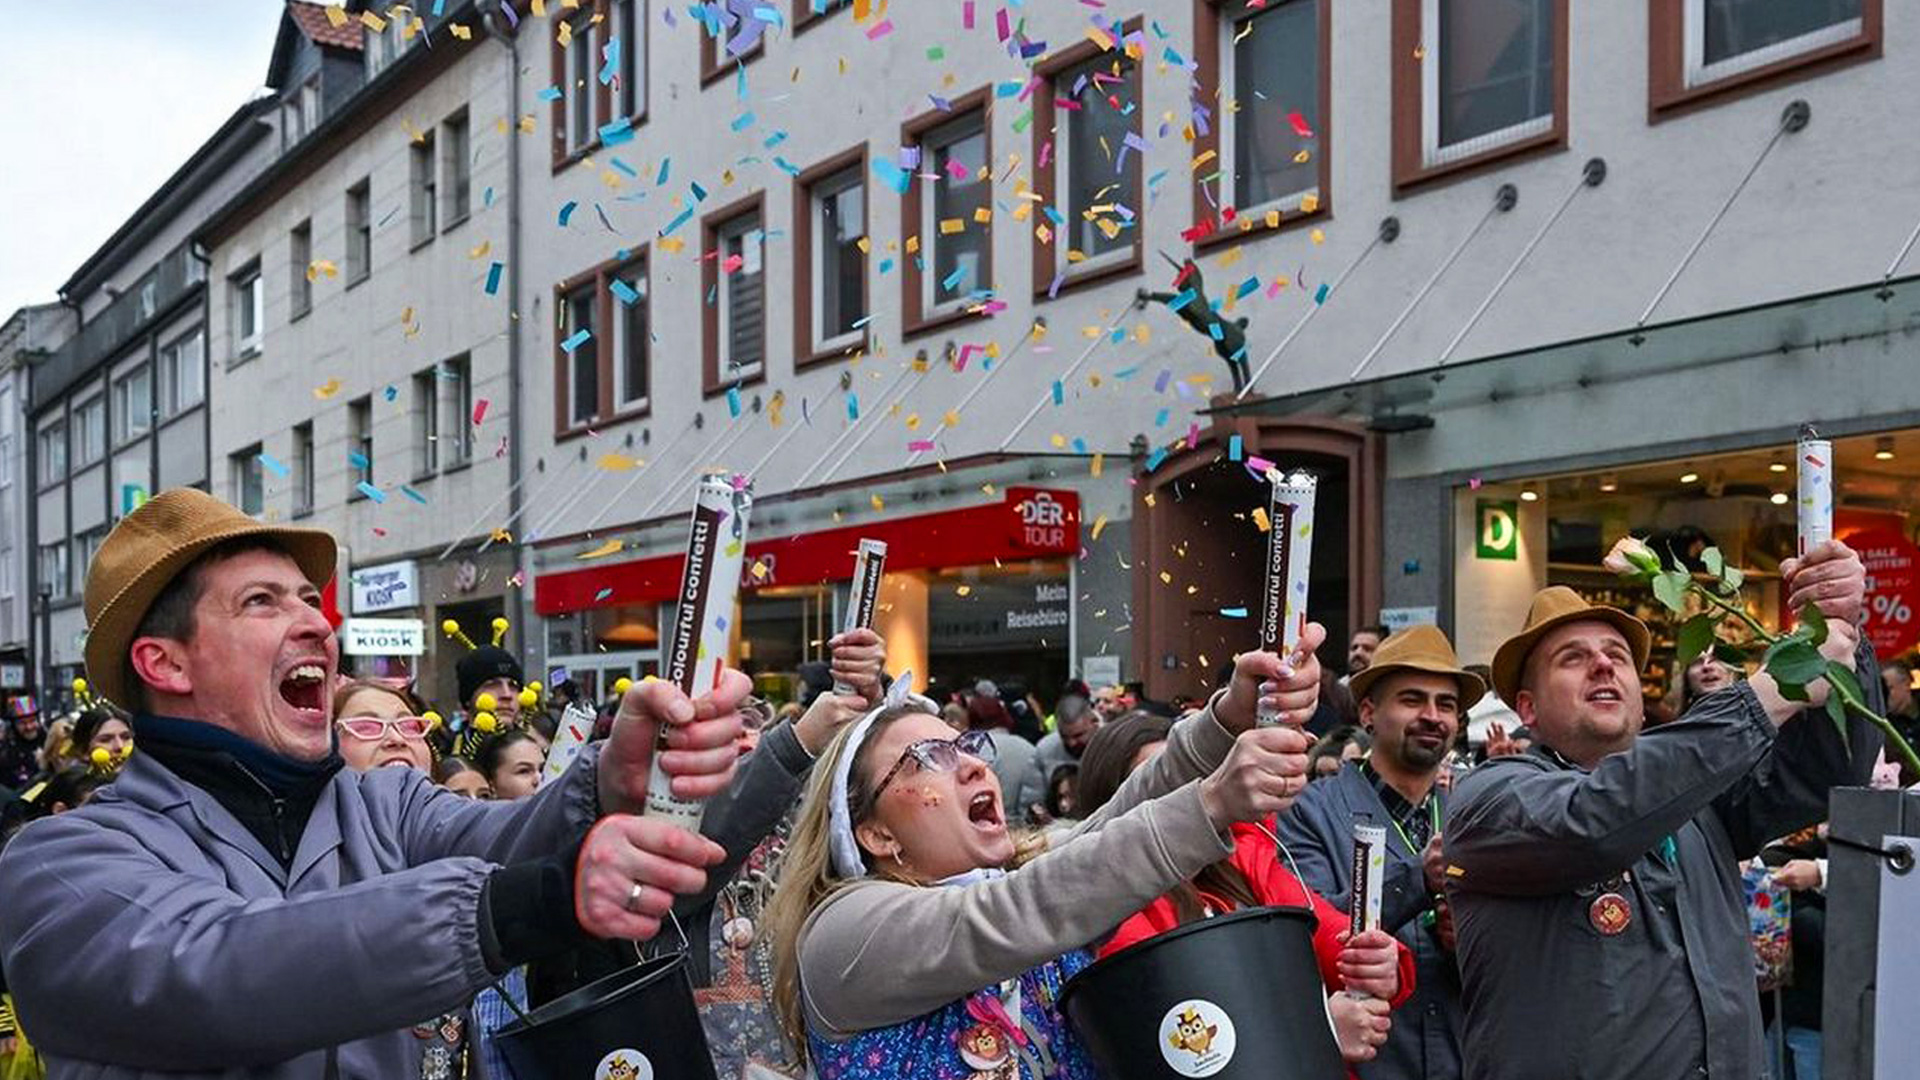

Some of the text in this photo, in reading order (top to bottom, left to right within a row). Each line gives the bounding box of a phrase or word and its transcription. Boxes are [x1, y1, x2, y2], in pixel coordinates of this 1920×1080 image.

[1023, 500, 1064, 525] DER
[1023, 526, 1065, 547] TOUR
[1483, 508, 1514, 551] D
[687, 520, 709, 600] confetti
[1265, 513, 1284, 643] Colourful confetti
[1036, 584, 1067, 601] Mein
[1007, 609, 1067, 629] Reisebüro
[357, 636, 413, 647] KIOSK
